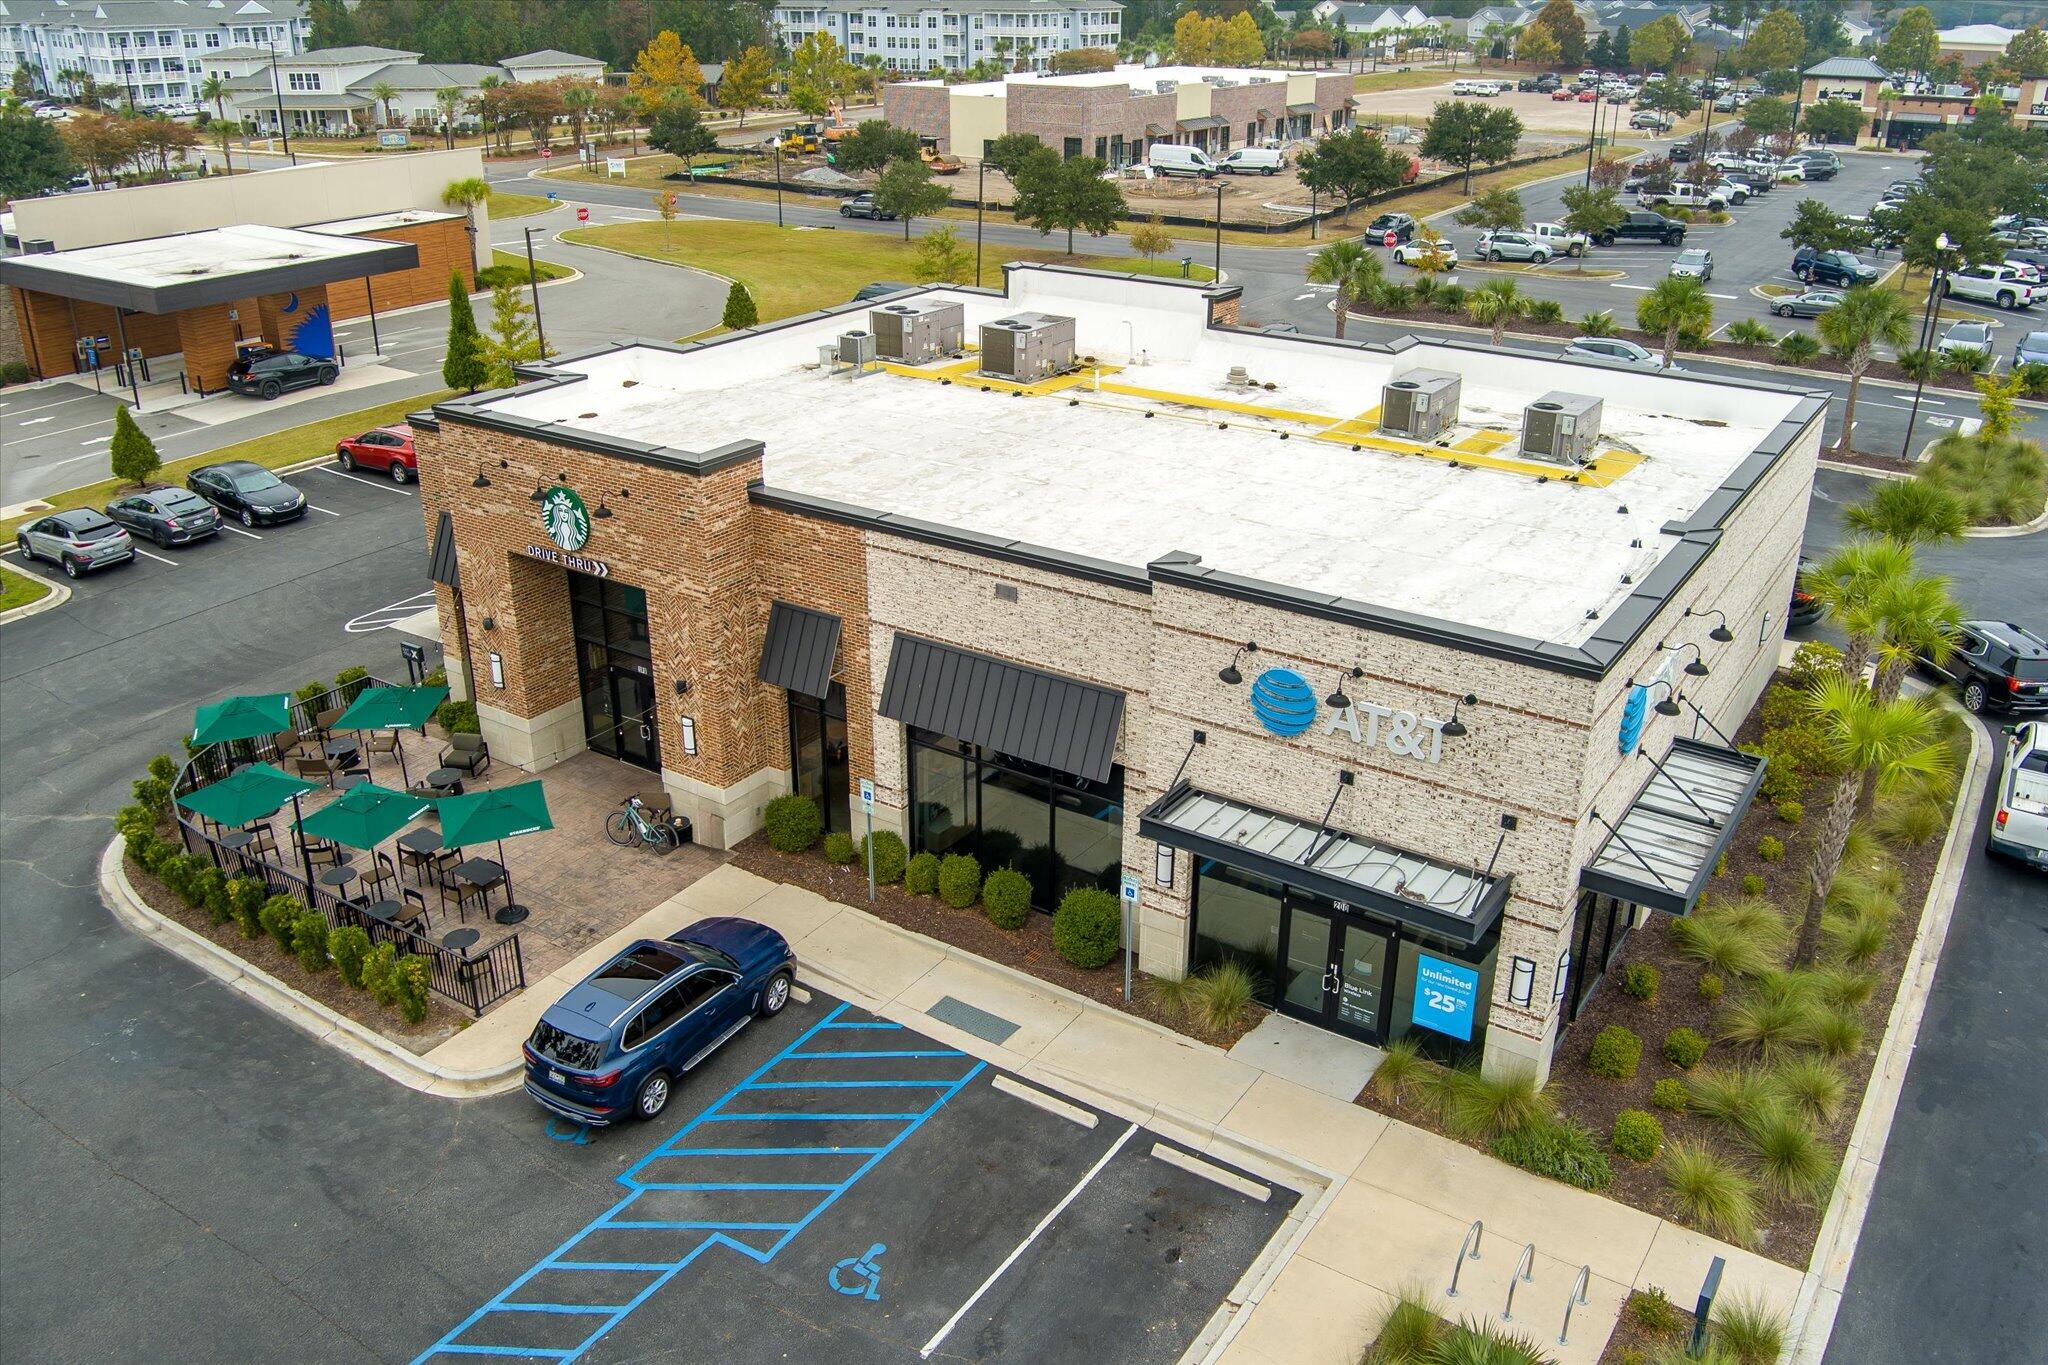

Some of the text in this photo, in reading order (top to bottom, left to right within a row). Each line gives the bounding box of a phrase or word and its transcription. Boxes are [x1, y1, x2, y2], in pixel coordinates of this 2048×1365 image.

[527, 545, 591, 572] DRIVE THRU
[1323, 699, 1447, 764] AT&T
[508, 825, 542, 836] STARBUCKS
[1344, 982, 1373, 997] Blue Link
[1422, 967, 1473, 991] Unlimited
[1424, 987, 1456, 1013] $25
